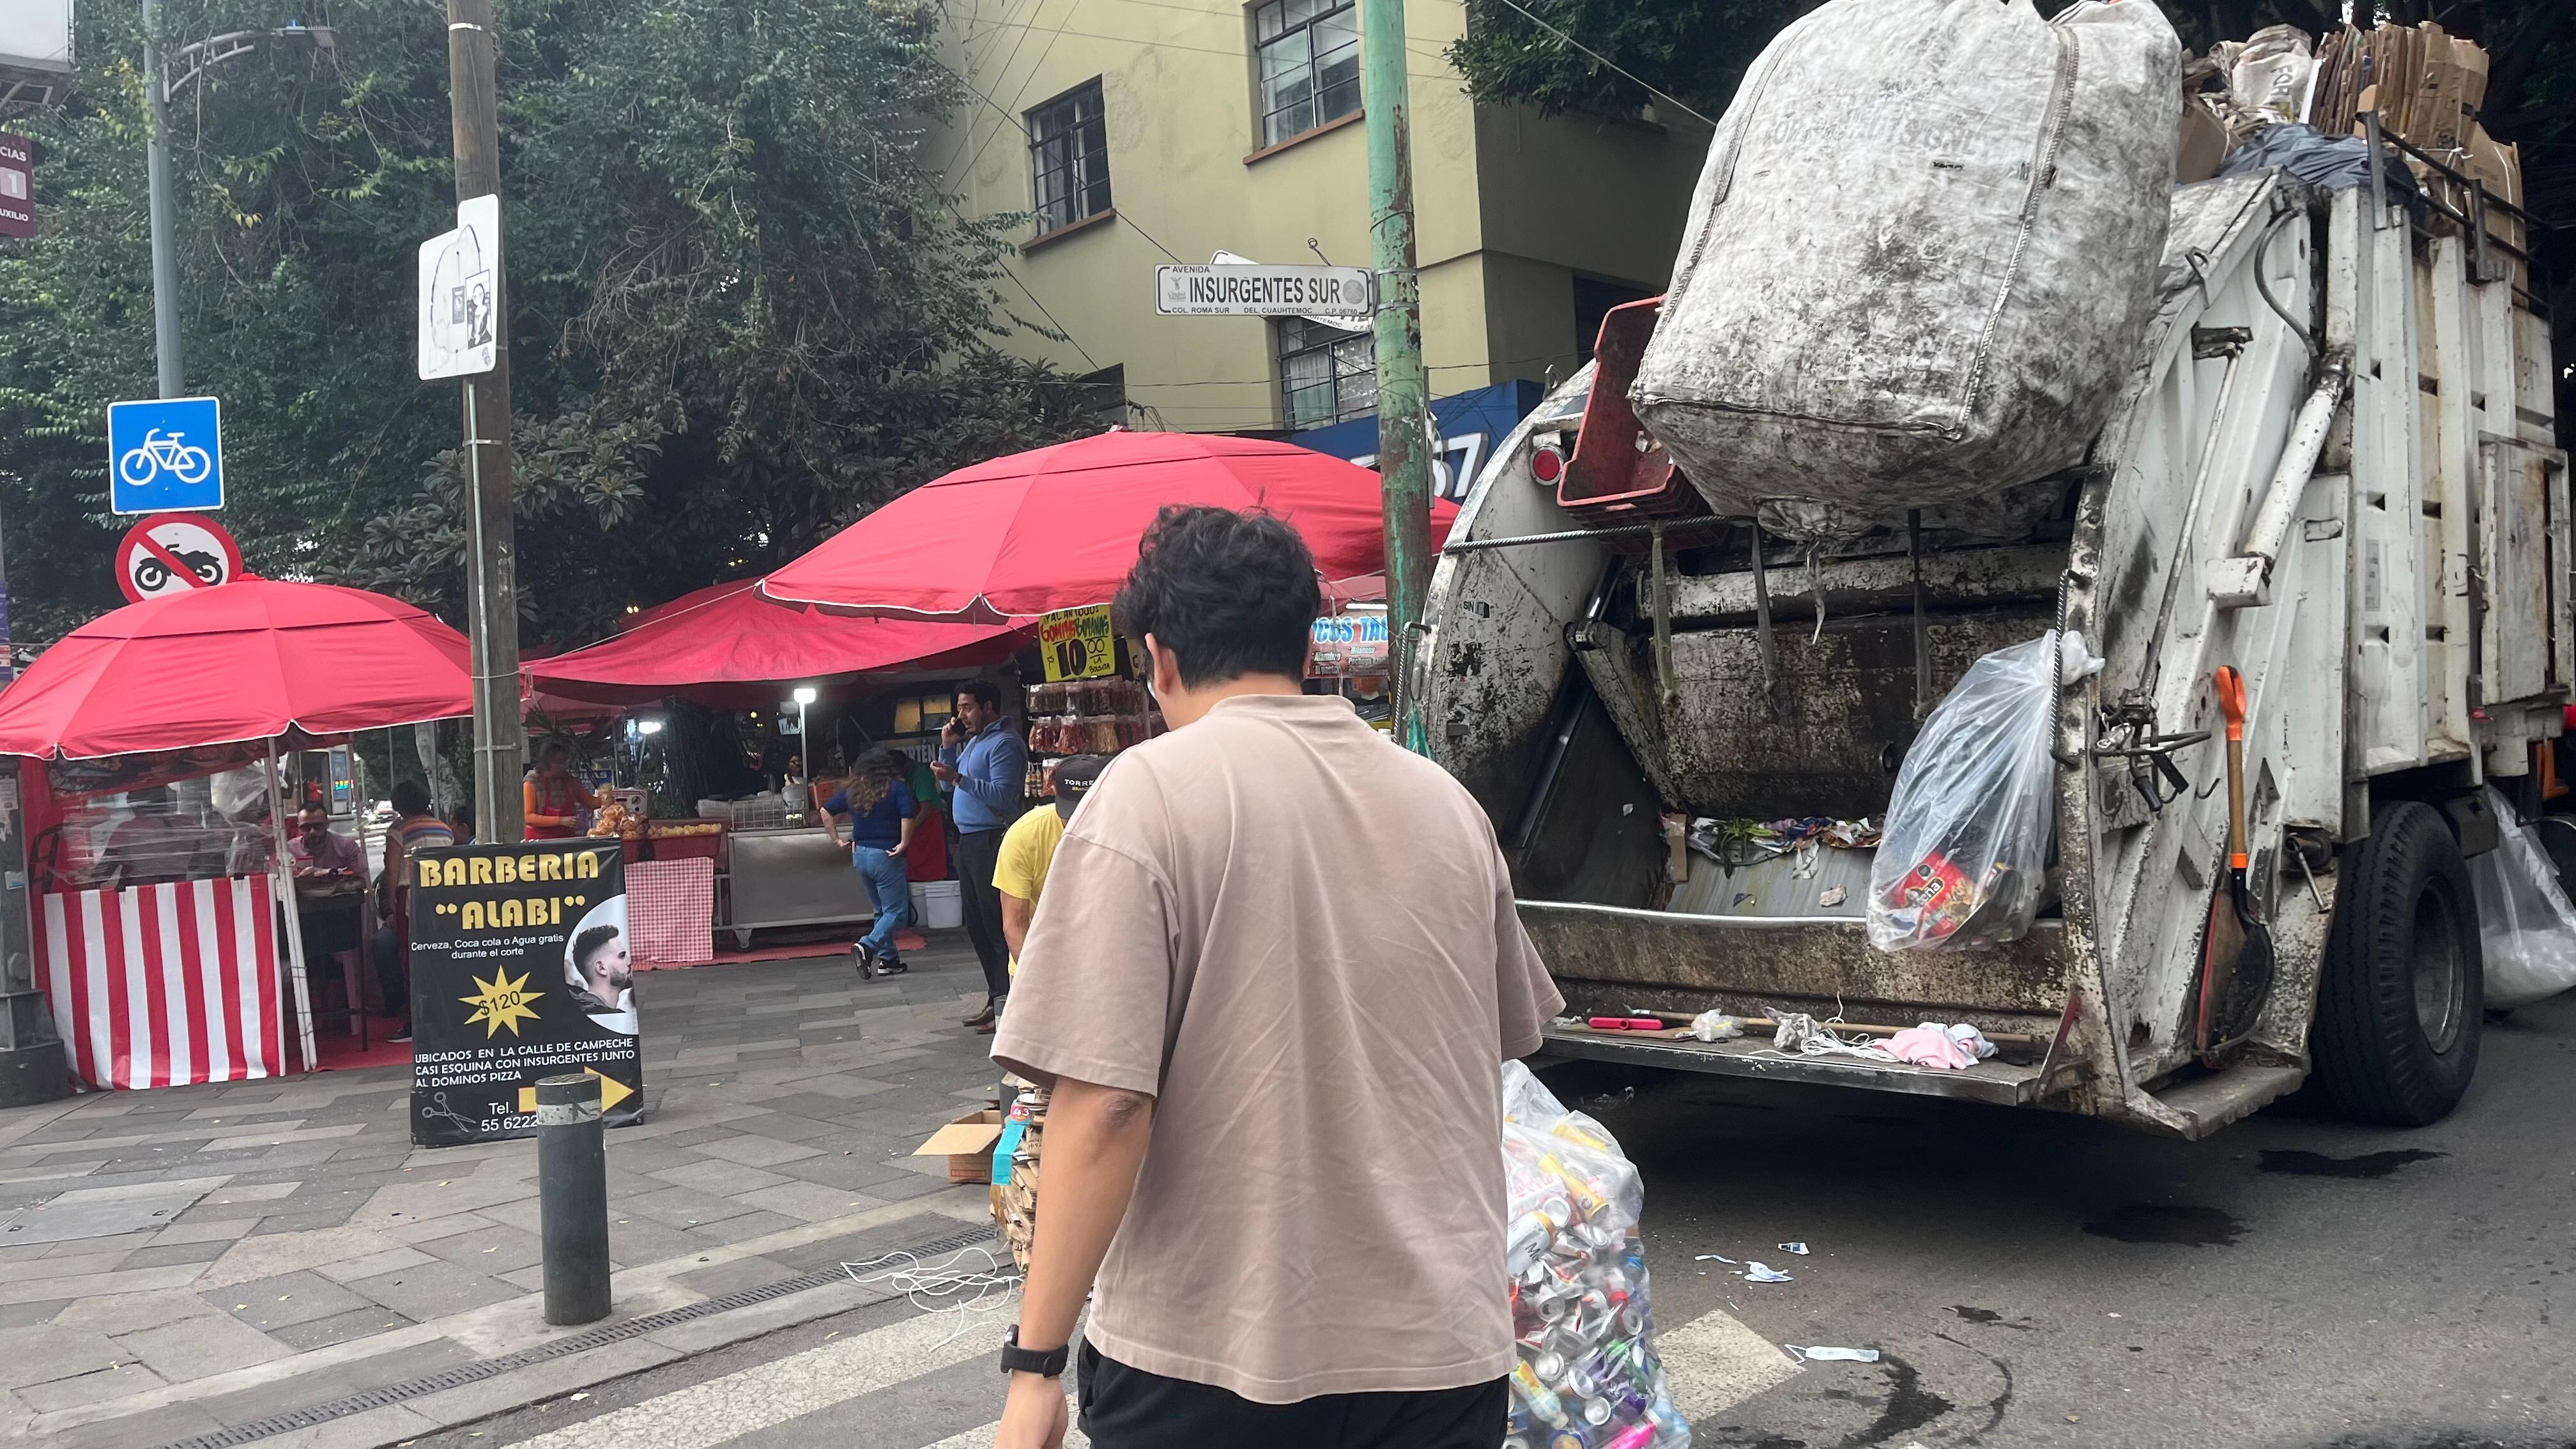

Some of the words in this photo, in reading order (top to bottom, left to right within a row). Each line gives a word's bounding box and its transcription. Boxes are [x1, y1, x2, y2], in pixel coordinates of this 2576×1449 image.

[1190, 277, 1303, 303] INSURGENTES
[1308, 277, 1341, 304] SUR
[1055, 639, 1087, 678] 10
[1089, 663, 1110, 673] BOLSITA
[419, 851, 599, 887] BARBERIA
[411, 941, 452, 951] Cerveza,
[454, 939, 480, 948] Coca
[482, 937, 502, 947] cola
[512, 936, 536, 947] Agua
[538, 933, 564, 944] gratis
[451, 949, 487, 960] durante
[500, 947, 524, 956] corte
[478, 991, 521, 1016] $120
[415, 1050, 471, 1064] UBICADOS
[478, 1048, 494, 1058] EN
[500, 1046, 516, 1057] LA
[518, 1045, 553, 1056] CALLE
[556, 1042, 571, 1052] DE
[574, 1038, 634, 1050] CAMPECHE
[415, 1065, 438, 1076] CASI
[441, 1061, 492, 1075] ESQUINA
[494, 1059, 521, 1070] CON
[523, 1053, 599, 1067] INSURGENTES
[601, 1050, 635, 1062] JUNTO
[415, 1078, 429, 1088] AL
[431, 1074, 487, 1087] DOMINOS
[489, 1071, 522, 1082] PIZZA
[488, 1102, 513, 1115] Tel.
[480, 1119, 500, 1132] 55
